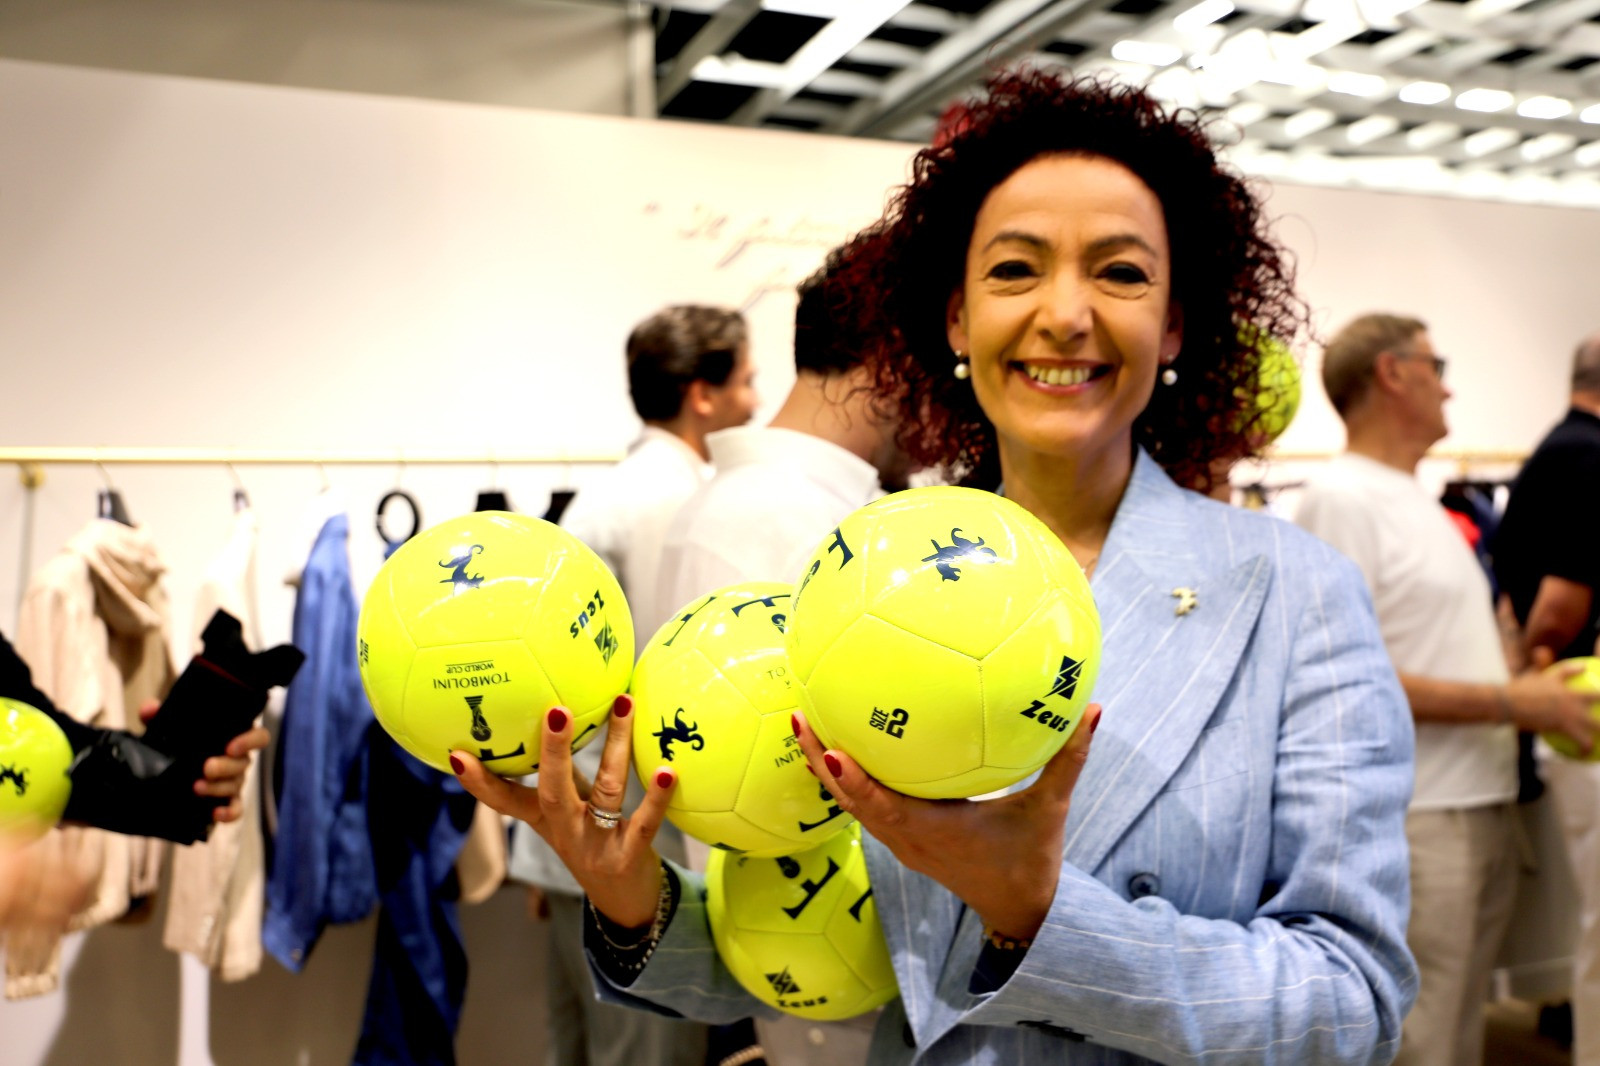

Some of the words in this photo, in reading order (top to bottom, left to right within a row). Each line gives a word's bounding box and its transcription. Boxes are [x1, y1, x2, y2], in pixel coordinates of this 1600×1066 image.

[569, 589, 605, 639] Zeus
[446, 666, 463, 674] CUP
[465, 662, 495, 673] WORLD
[432, 672, 512, 690] TOMBOLINI
[869, 706, 890, 731] SIZE
[885, 708, 910, 740] 2
[1019, 699, 1071, 733] Zeus
